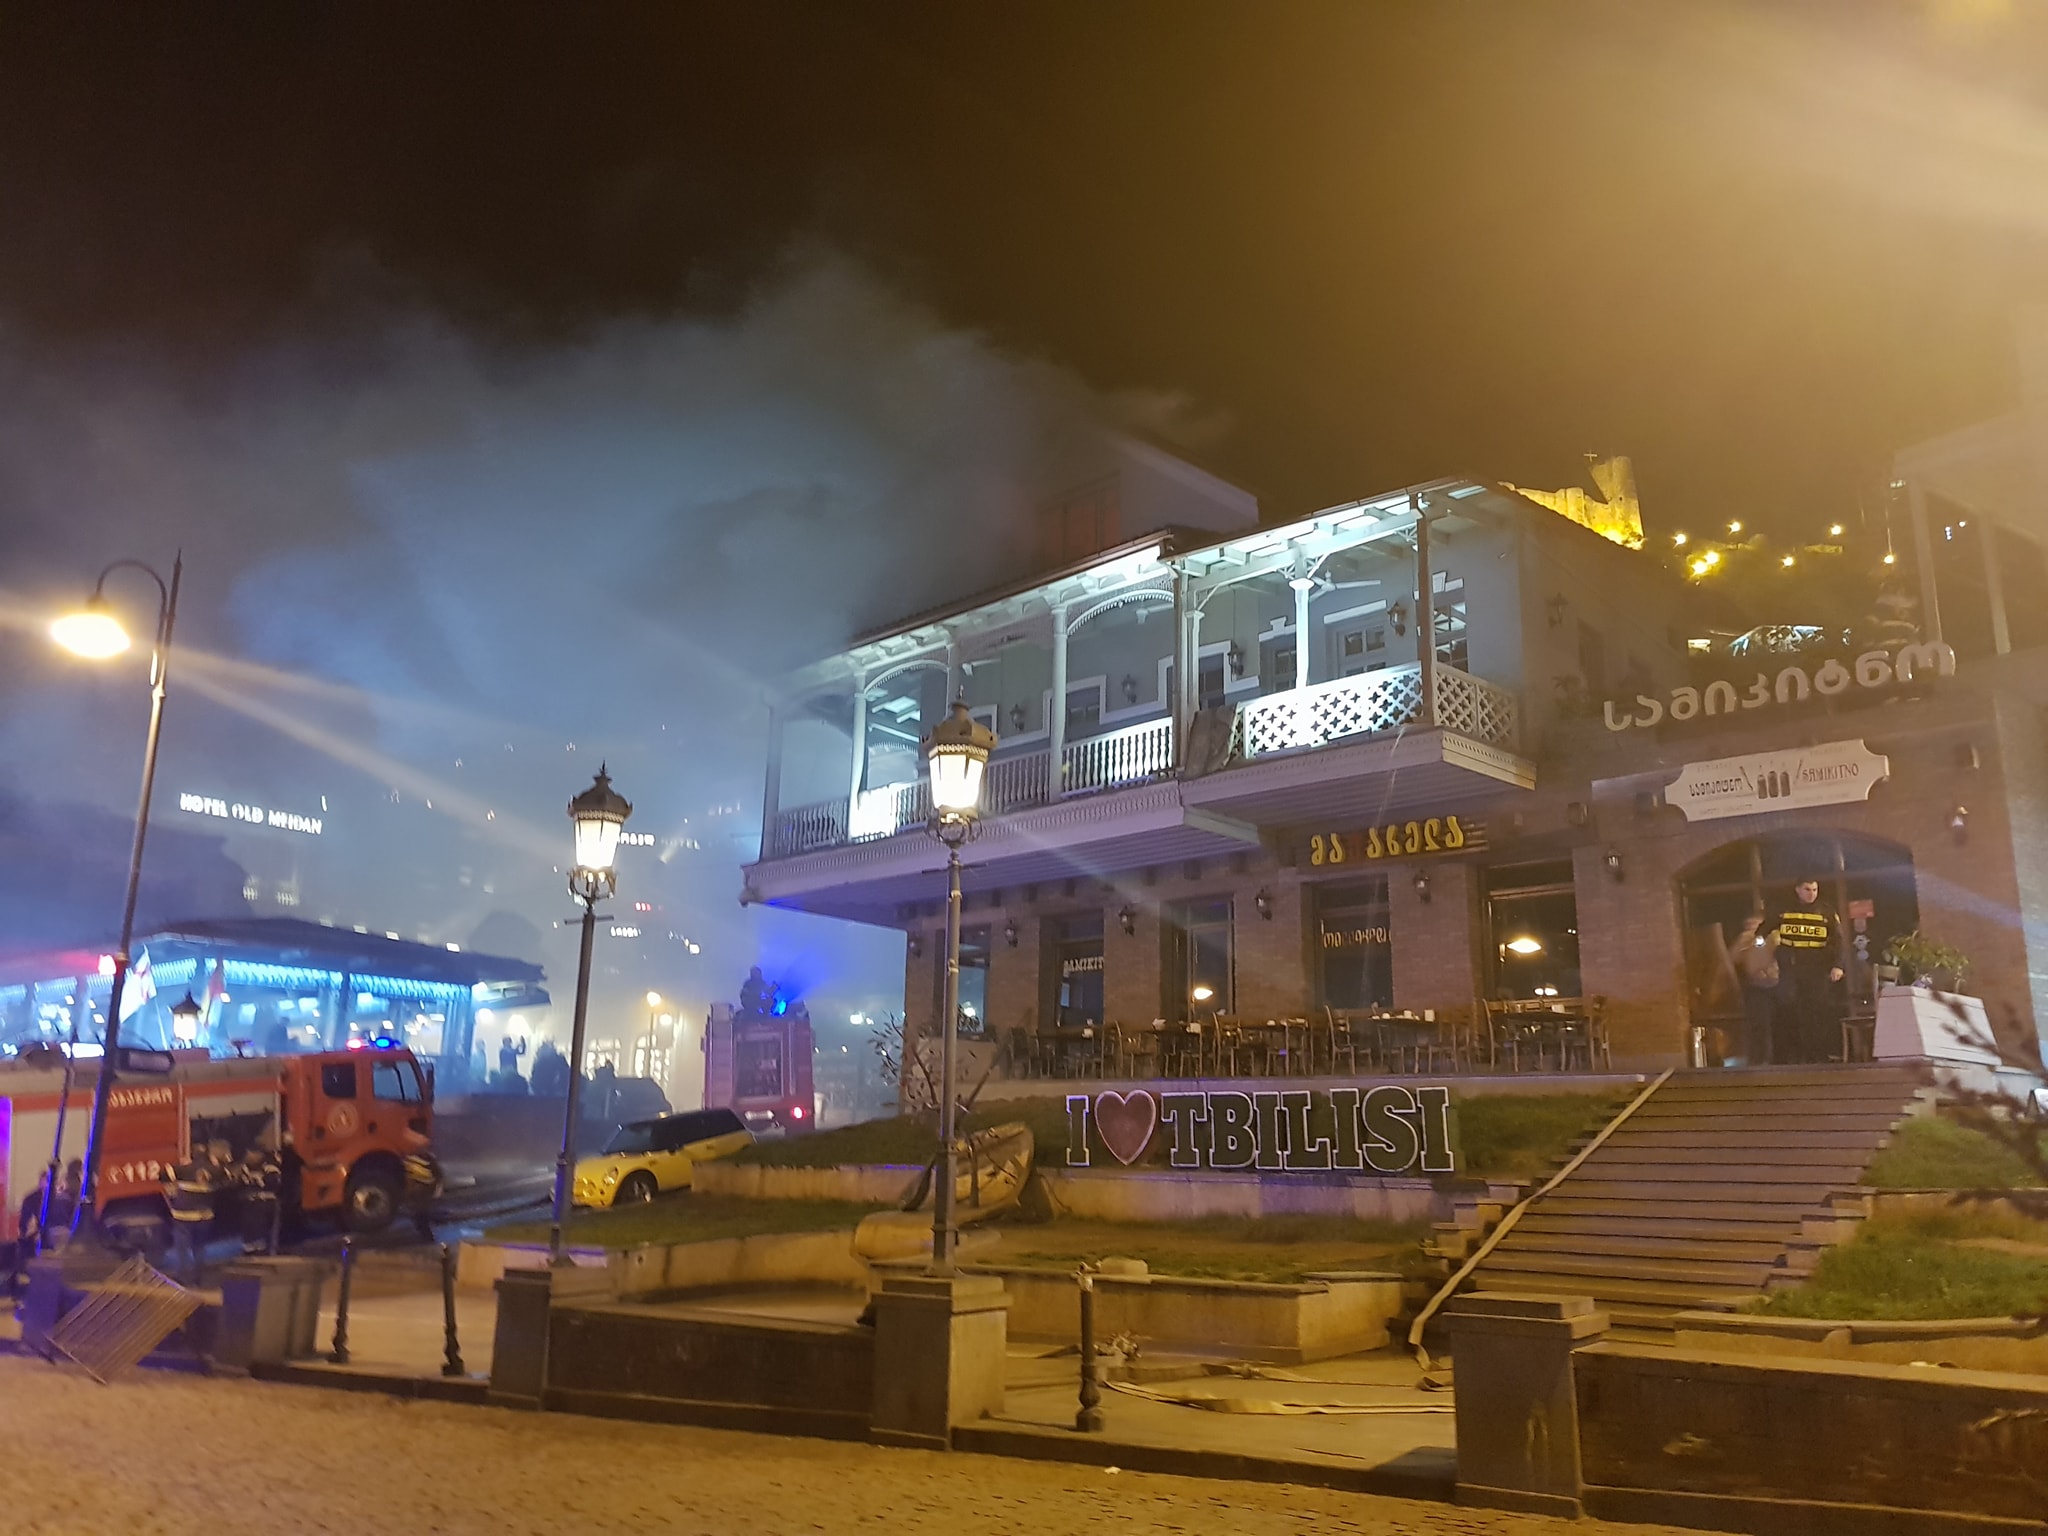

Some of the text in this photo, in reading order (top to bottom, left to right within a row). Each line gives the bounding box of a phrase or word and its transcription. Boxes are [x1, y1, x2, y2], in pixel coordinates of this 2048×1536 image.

[1603, 641, 1956, 732] სამიკიტნო
[231, 802, 264, 824] OLD
[1785, 925, 1821, 936] POLICE
[1065, 1085, 1454, 1173] I TBILISI
